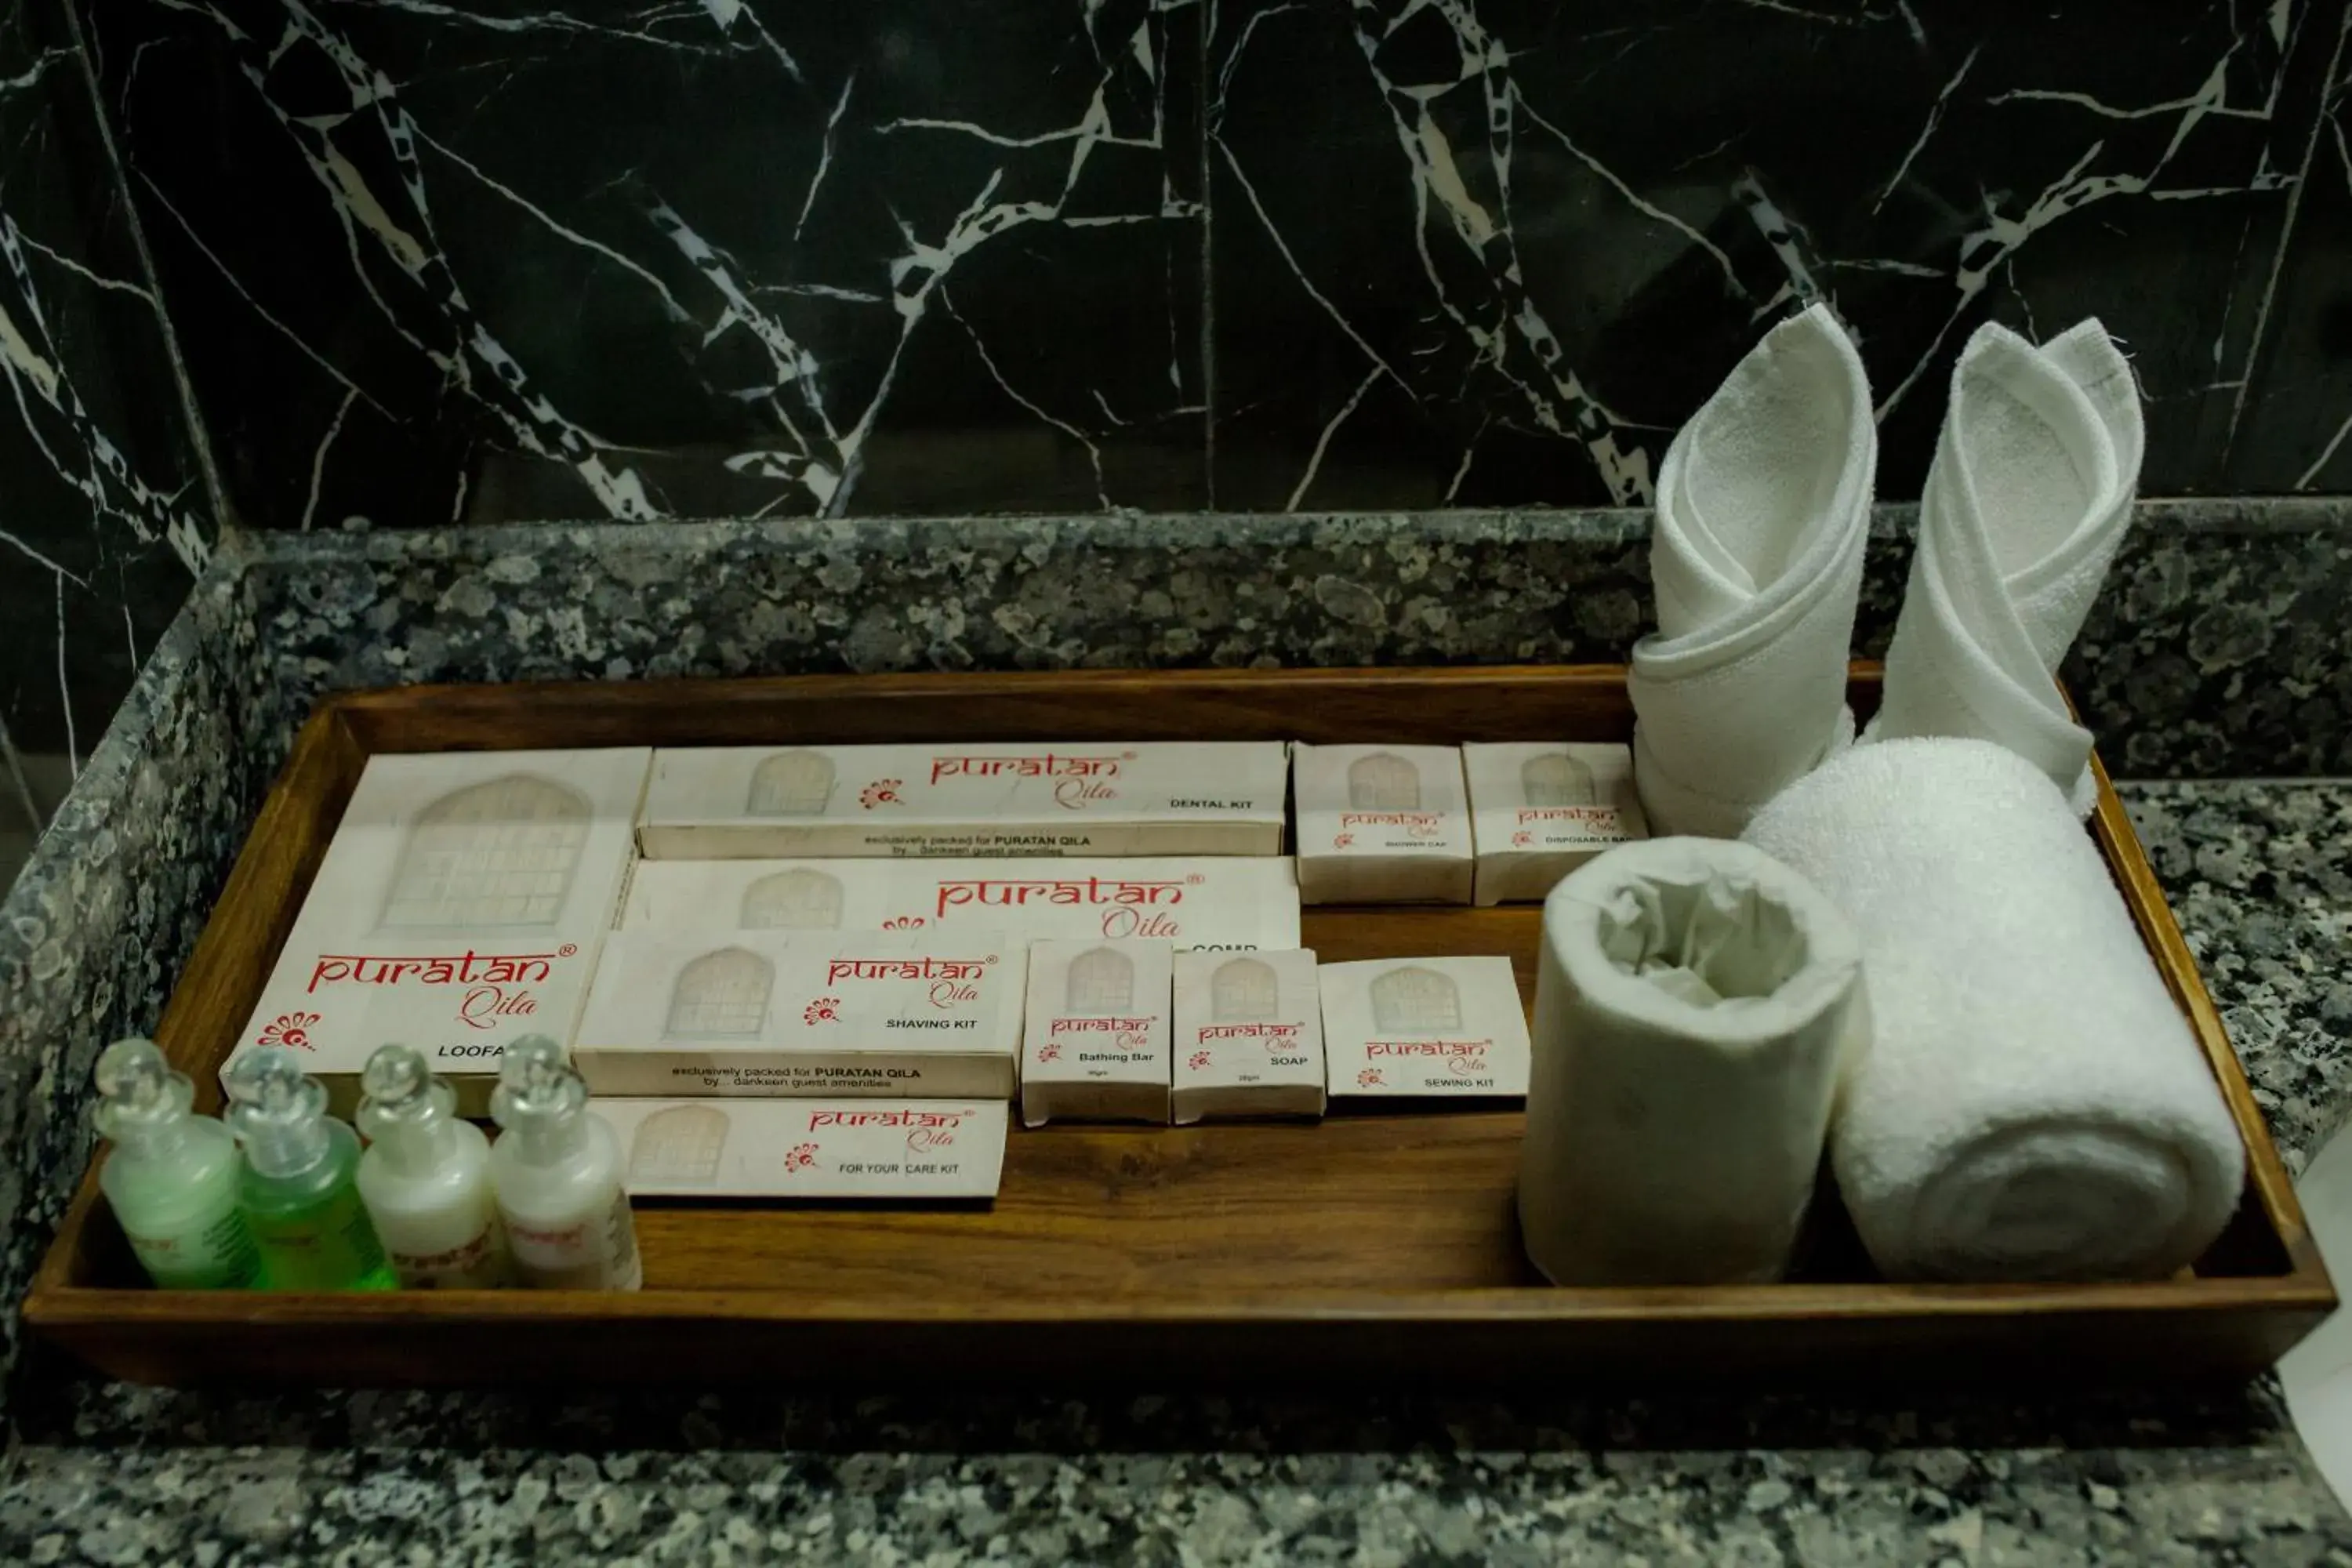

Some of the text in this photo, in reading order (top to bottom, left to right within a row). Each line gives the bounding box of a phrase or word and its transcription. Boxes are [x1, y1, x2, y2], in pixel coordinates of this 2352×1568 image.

[1054, 778, 1117, 810] Qila
[1171, 799, 1253, 810] DENTAL KIT
[865, 835, 1091, 847] exclusively packed for PURATAN QILA
[1102, 906, 1182, 939] Qila
[928, 979, 978, 1009] Qila
[453, 985, 539, 1029] Qila
[886, 1019, 978, 1029] SHAVING KIT
[1115, 1031, 1148, 1051] Qila
[1079, 1053, 1155, 1063] Bathing Bar
[1270, 1057, 1308, 1066] SOAP
[672, 1066, 921, 1079] exclusively packed for PURATAN QILA
[1448, 1056, 1487, 1076] Qila
[791, 1077, 827, 1089] guest
[830, 1076, 892, 1087] amenities
[1424, 1078, 1494, 1087] SEWING KIT
[906, 1127, 954, 1154] Qila
[839, 1163, 960, 1174] FOR YOUR CARE KIT
